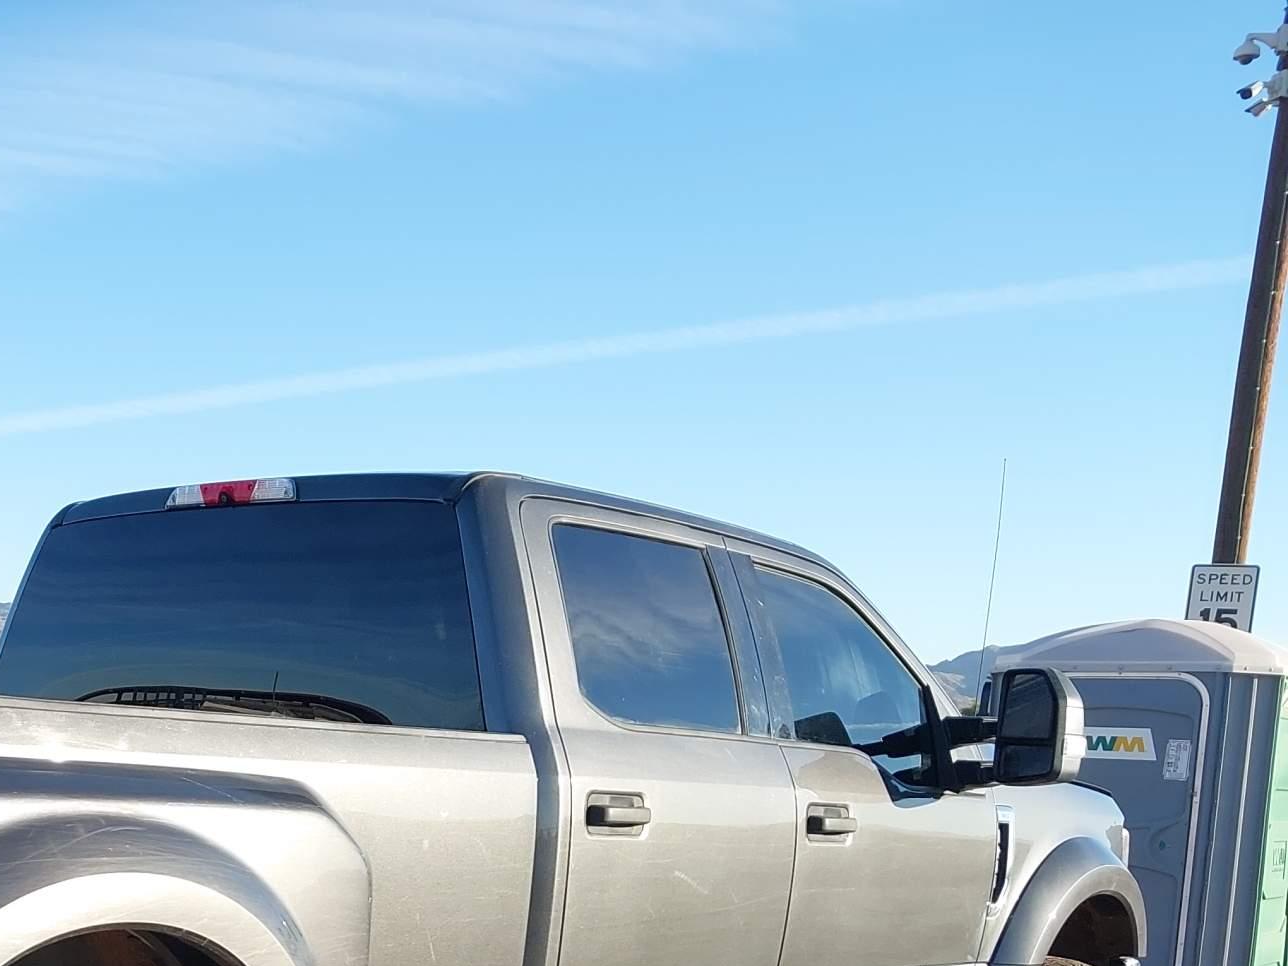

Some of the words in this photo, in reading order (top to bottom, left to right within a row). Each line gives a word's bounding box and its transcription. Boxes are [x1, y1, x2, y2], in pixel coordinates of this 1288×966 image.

[1196, 572, 1253, 585] SPEED
[1199, 590, 1245, 602] LIMIT
[1085, 735, 1145, 753] WM
